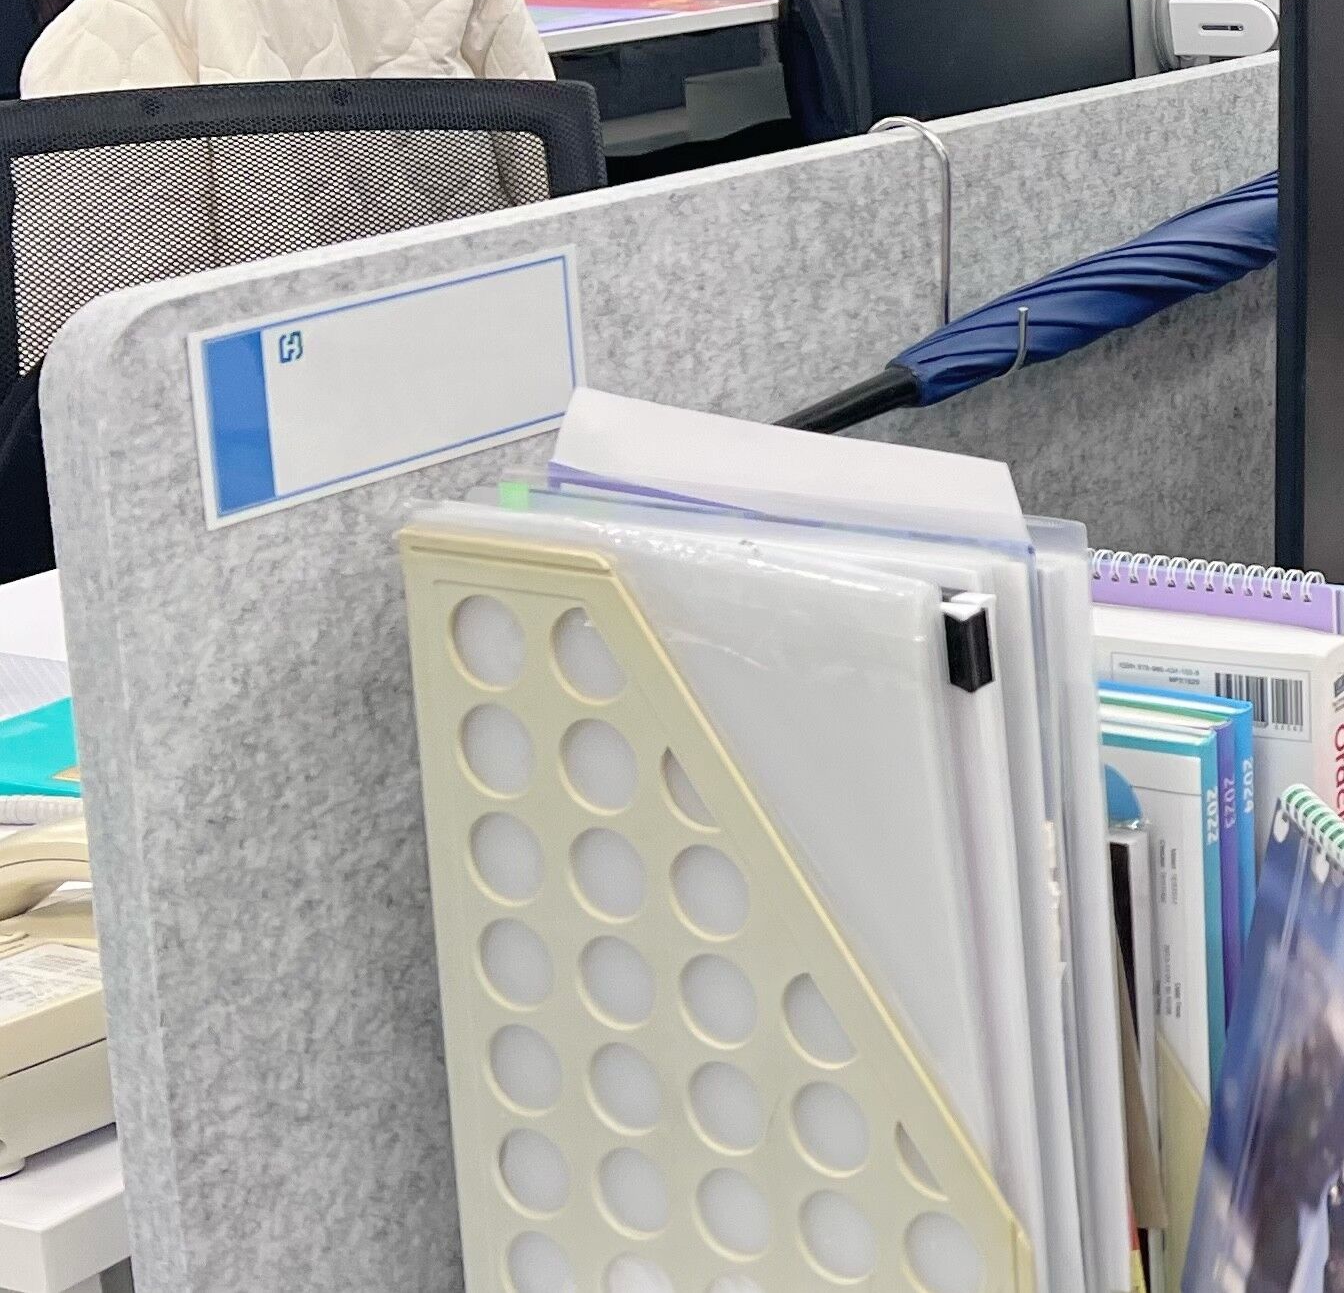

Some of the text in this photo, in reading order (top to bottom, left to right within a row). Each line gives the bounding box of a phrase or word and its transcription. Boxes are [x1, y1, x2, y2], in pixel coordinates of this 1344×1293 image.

[1223, 777, 1237, 829] 2023
[1242, 758, 1254, 814] 2024
[1206, 786, 1218, 846] 2022
